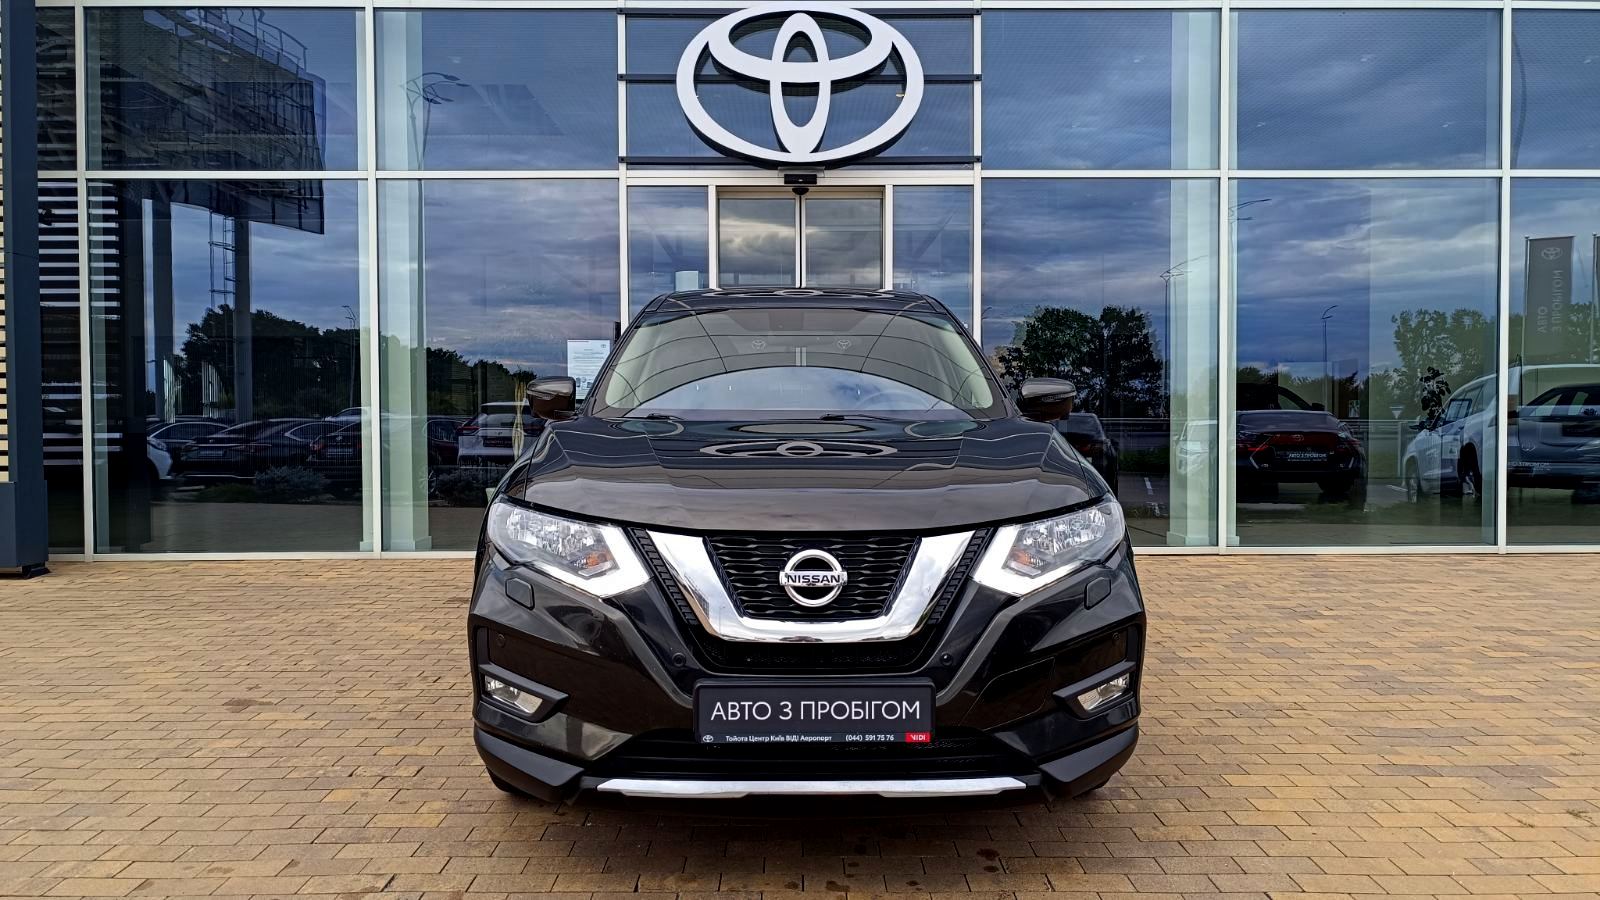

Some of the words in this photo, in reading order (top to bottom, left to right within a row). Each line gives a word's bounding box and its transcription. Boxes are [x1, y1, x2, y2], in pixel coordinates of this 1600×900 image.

[787, 574, 840, 584] NISSAN
[711, 701, 772, 720] АВТО
[800, 701, 920, 720] ПРОБІГОМ
[748, 735, 770, 743] Центр
[800, 735, 832, 743] Аеропорт
[845, 734, 863, 742] (044)
